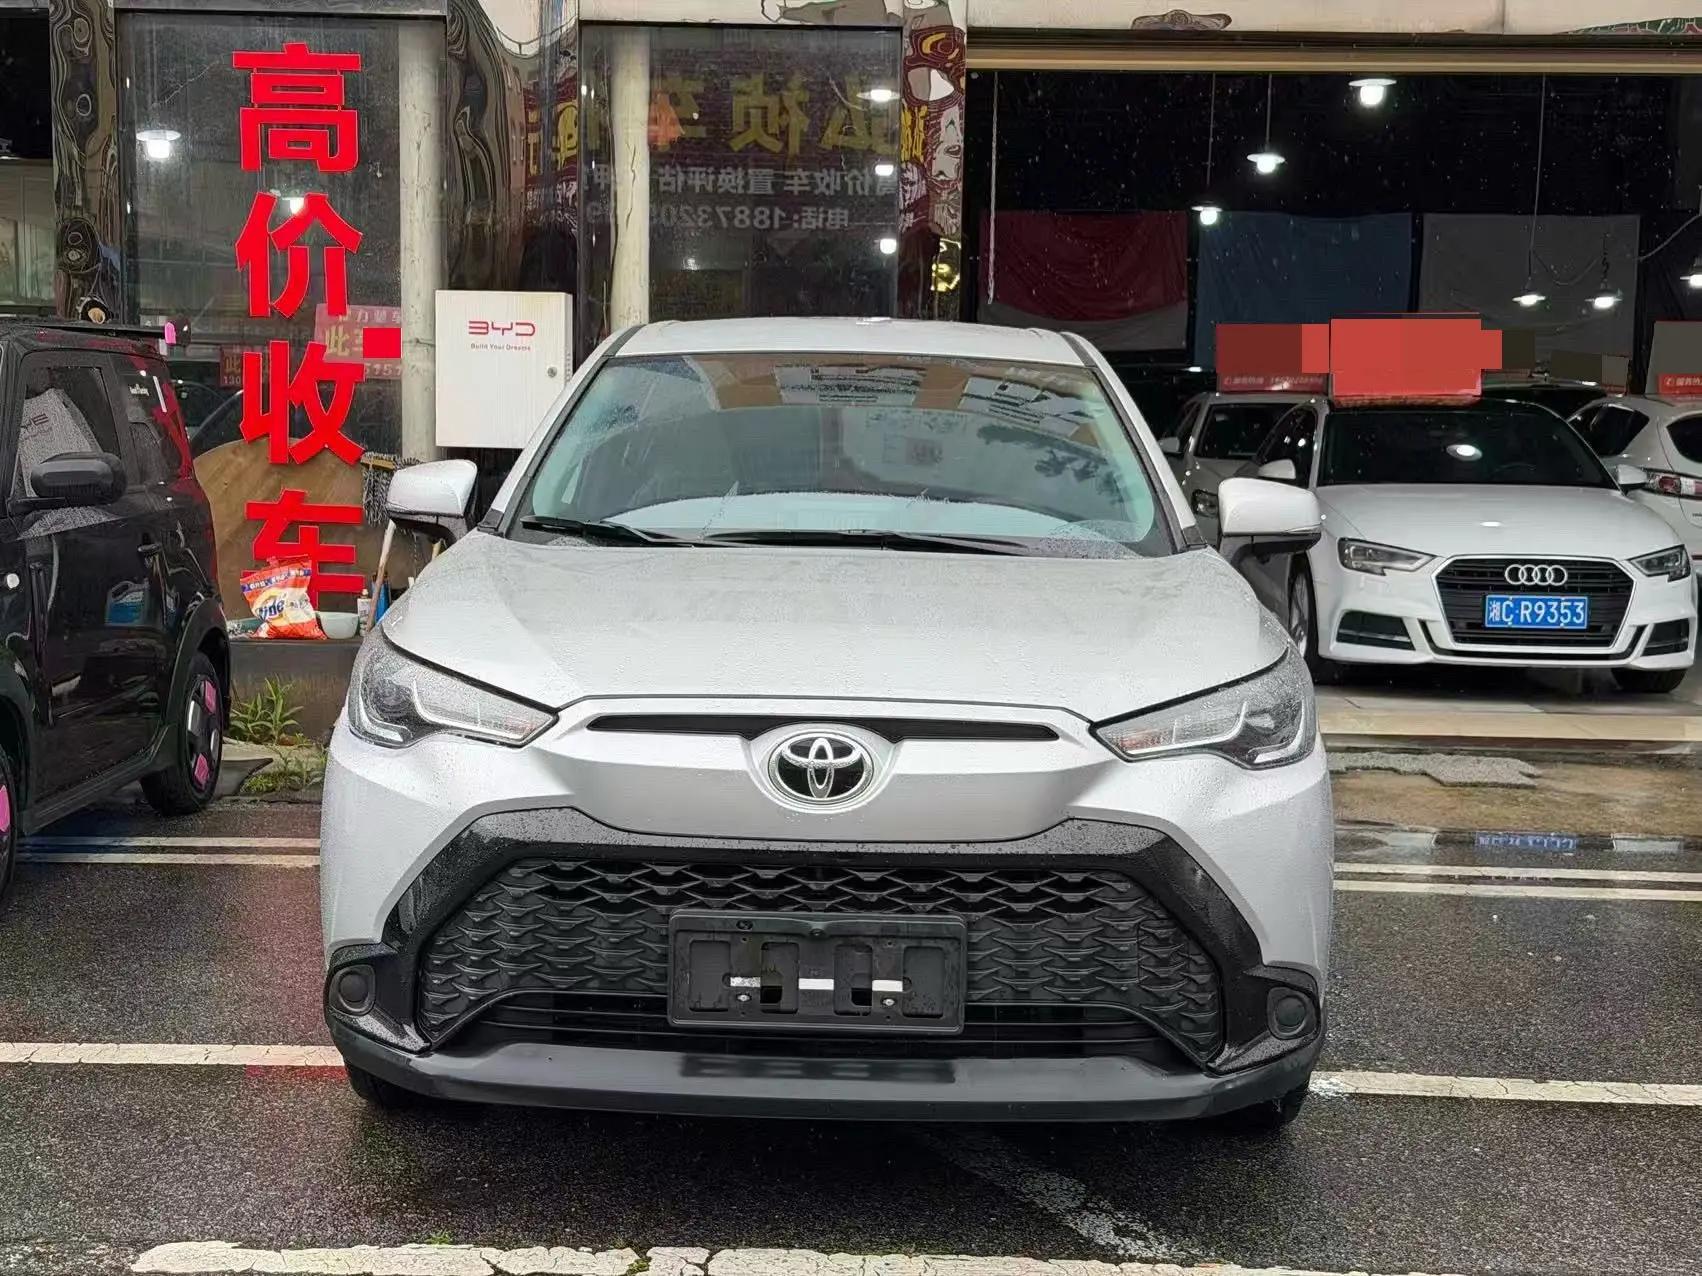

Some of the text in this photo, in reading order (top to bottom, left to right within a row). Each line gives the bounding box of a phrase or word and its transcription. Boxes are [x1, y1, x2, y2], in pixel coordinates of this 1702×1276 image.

[232, 42, 365, 610] 高价收车
[468, 320, 536, 336] BYD
[490, 343, 505, 351] Your
[506, 344, 532, 352] Dreams
